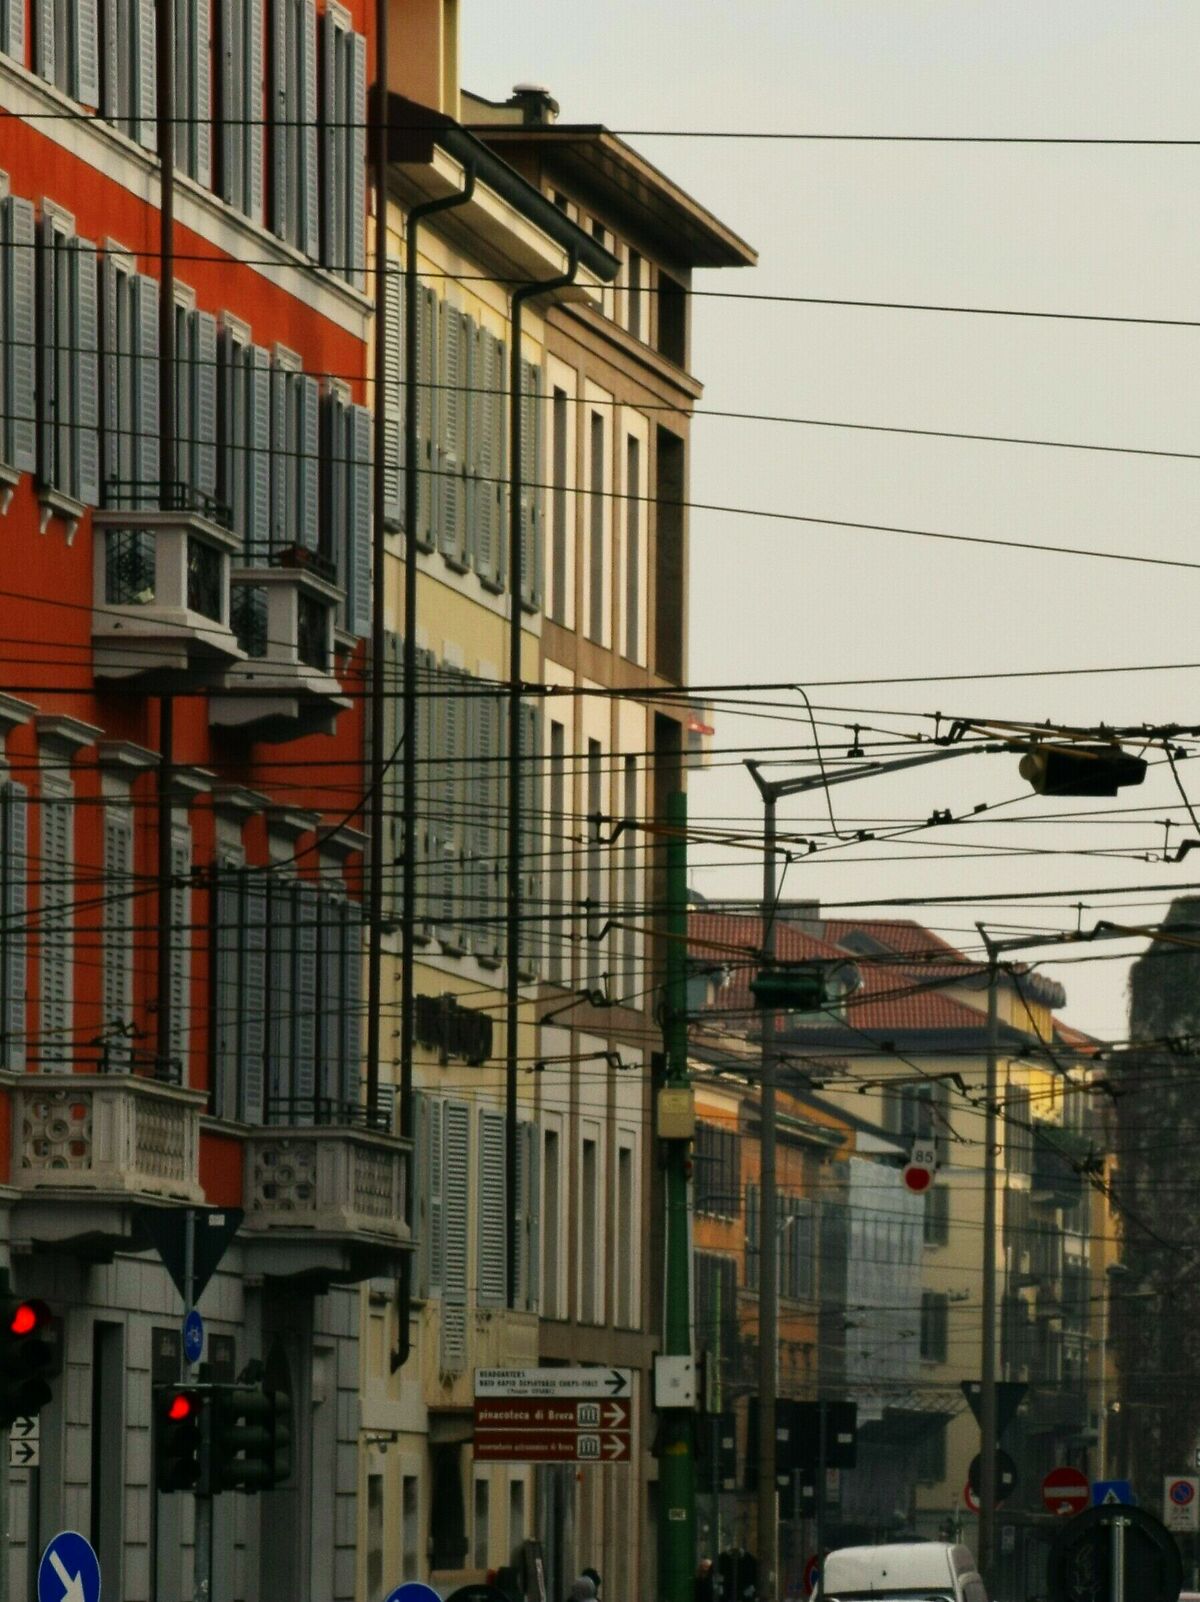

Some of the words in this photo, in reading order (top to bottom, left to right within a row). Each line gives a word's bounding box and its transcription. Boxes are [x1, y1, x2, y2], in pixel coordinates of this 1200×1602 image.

[915, 1150, 933, 1163] 85
[478, 1409, 530, 1422] pinacoteca
[534, 1409, 544, 1420] di
[548, 1409, 574, 1420] Brera
